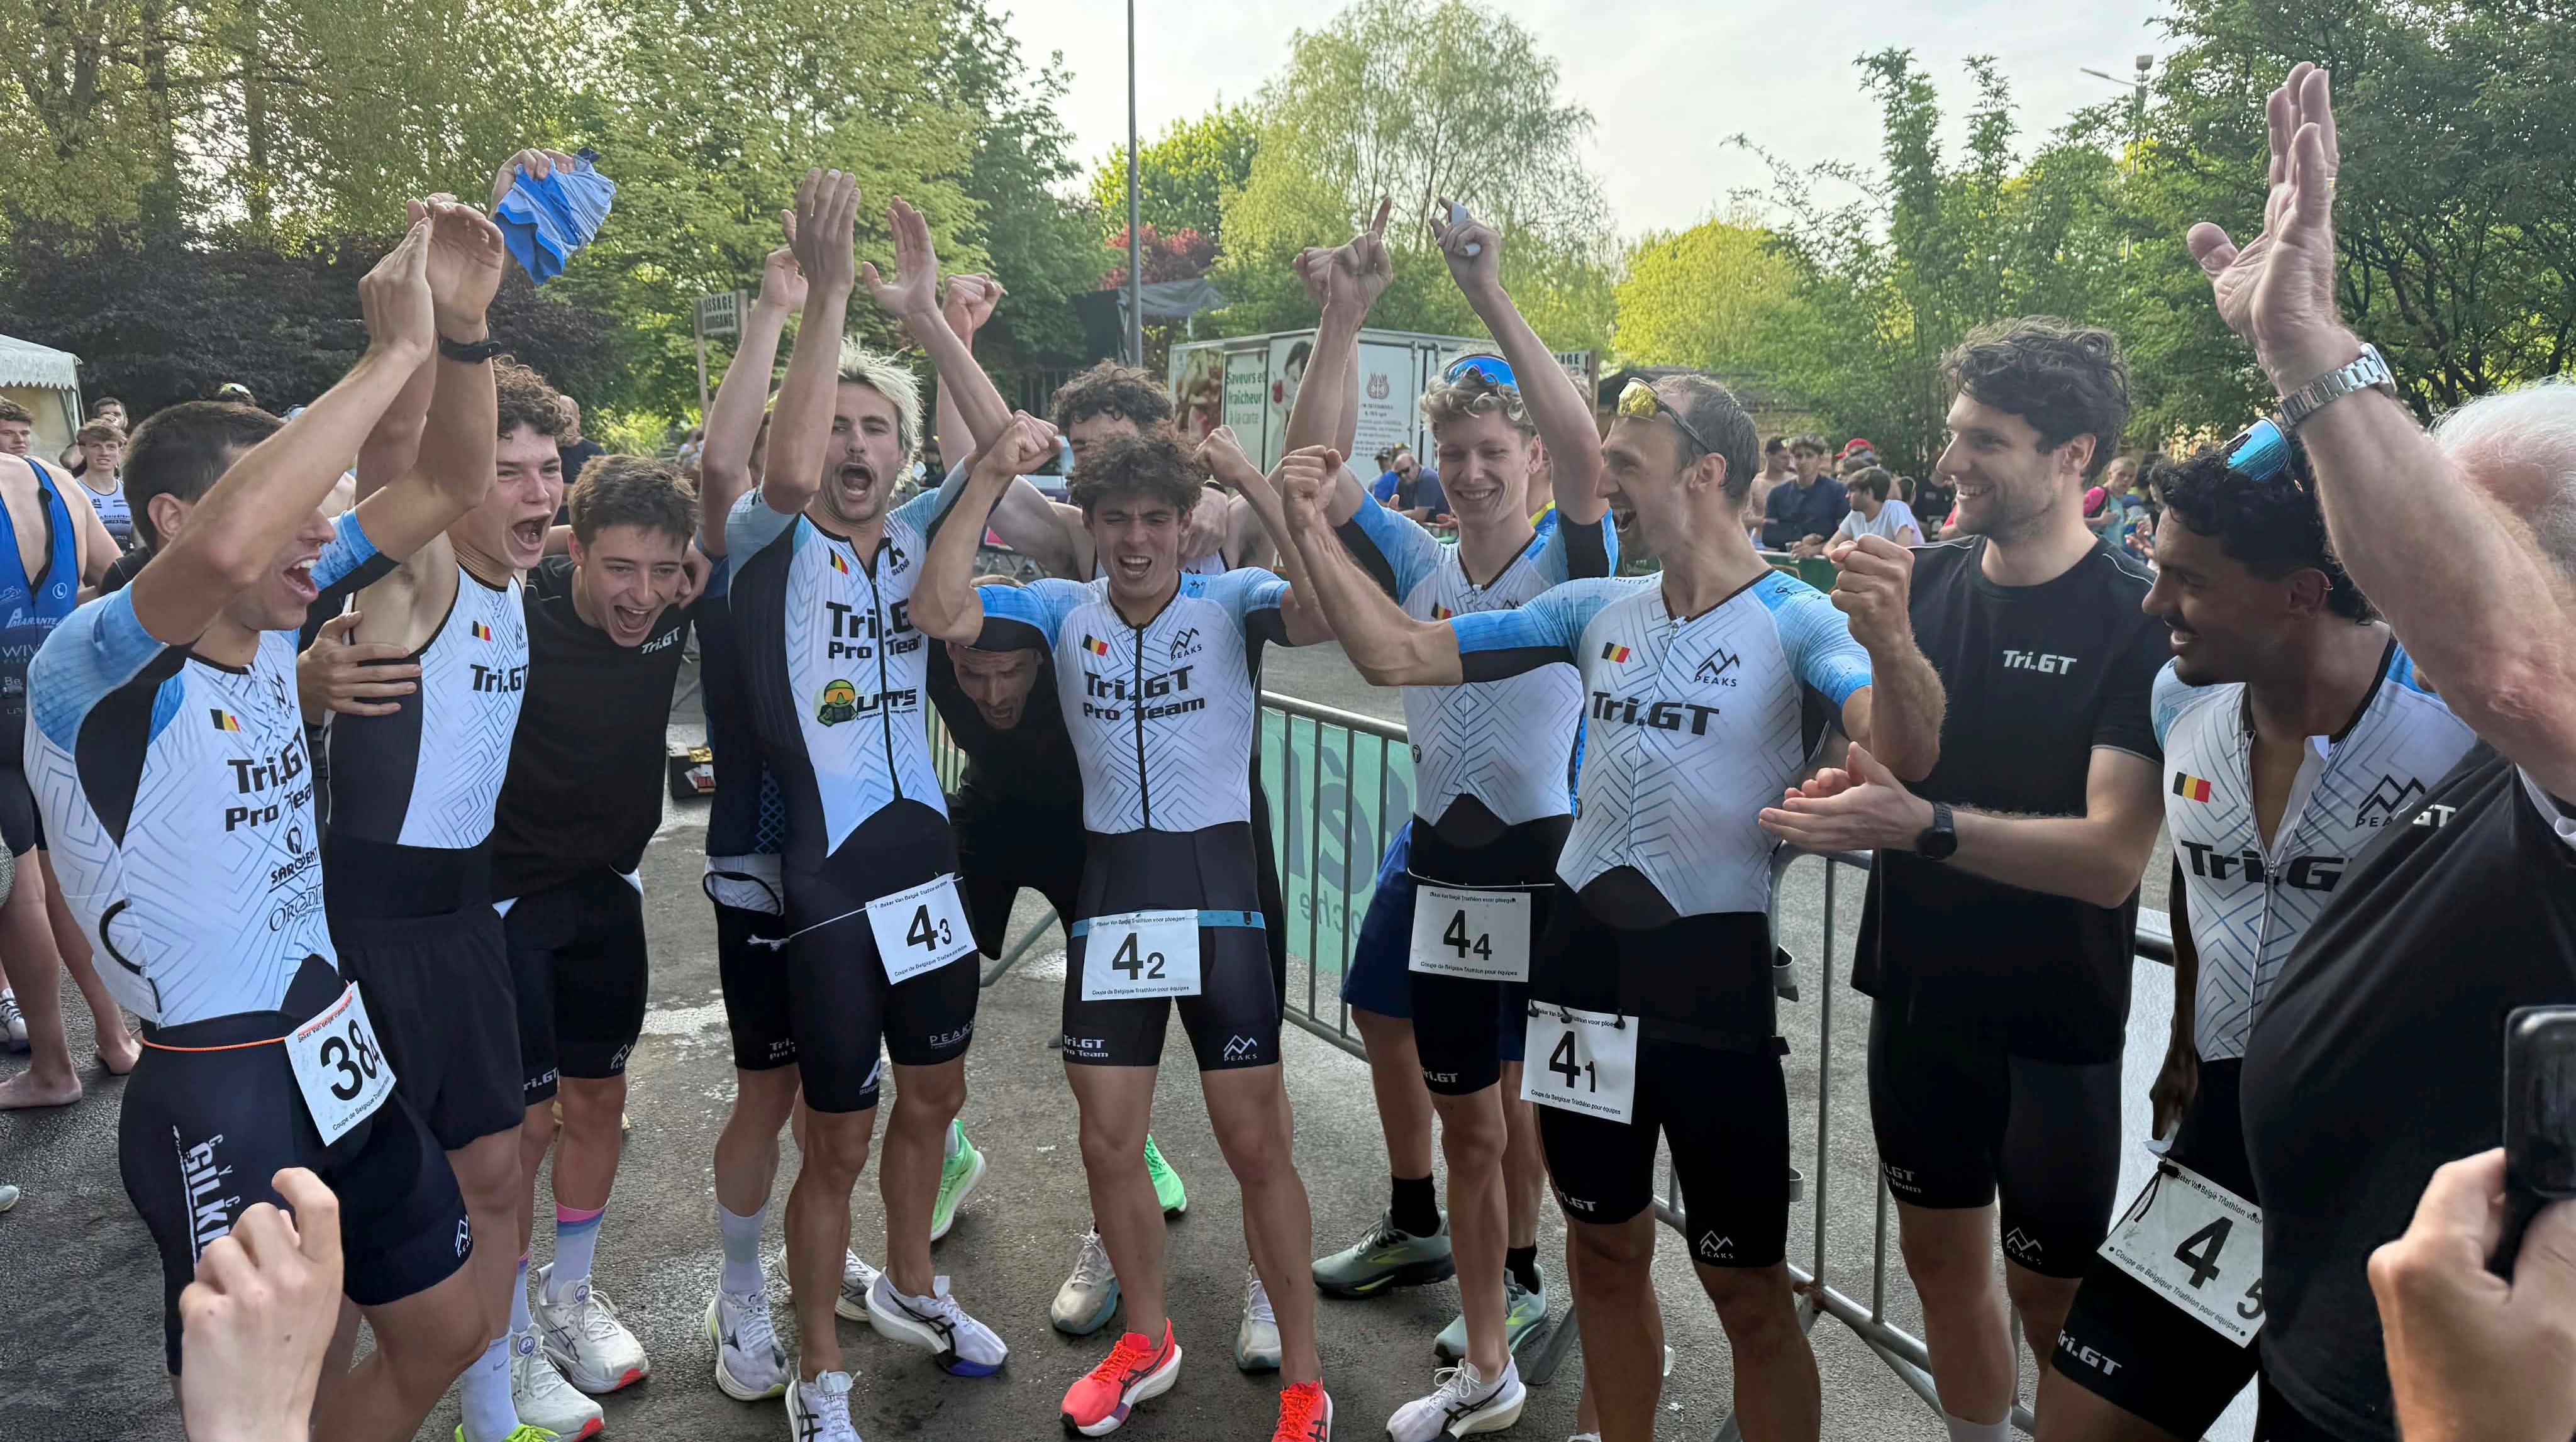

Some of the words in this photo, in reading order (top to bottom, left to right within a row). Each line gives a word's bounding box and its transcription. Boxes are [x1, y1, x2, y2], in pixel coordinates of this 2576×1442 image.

[826, 598, 913, 639] Tri.G
[641, 626, 680, 654] Tri.GT
[828, 641, 872, 660] Pro
[1171, 643, 1202, 660] PEAKS
[2002, 650, 2078, 675] Tri.GT
[470, 663, 528, 693] Tri.GT
[1085, 665, 1194, 701] Tri.GT
[1694, 675, 1737, 687] PEAKS
[1083, 701, 1120, 721] Pro
[1130, 697, 1205, 721] Team
[1593, 690, 1720, 736] Tri.GT
[227, 726, 309, 794] Tri.GT
[226, 803, 279, 832] Pro
[284, 782, 313, 813] Tea
[2355, 816, 2394, 828] PEA
[2181, 840, 2347, 892] Tri.G
[1224, 1053, 1258, 1062] PEAKS
[523, 1067, 558, 1091] ri.GT
[333, 1116, 350, 1131] Coupe
[349, 1111, 356, 1120] de
[187, 1142, 230, 1245] GILKI
[2201, 1184, 2218, 1200] België
[2218, 1195, 2245, 1216] Triathlon
[2116, 1248, 2136, 1267] Coupe
[2136, 1263, 2145, 1273] de
[2145, 1268, 2173, 1290] Belgique
[2173, 1286, 2200, 1309] Triathlon
[2199, 1305, 2215, 1317] pour
[2214, 1313, 2240, 1333] équipes
